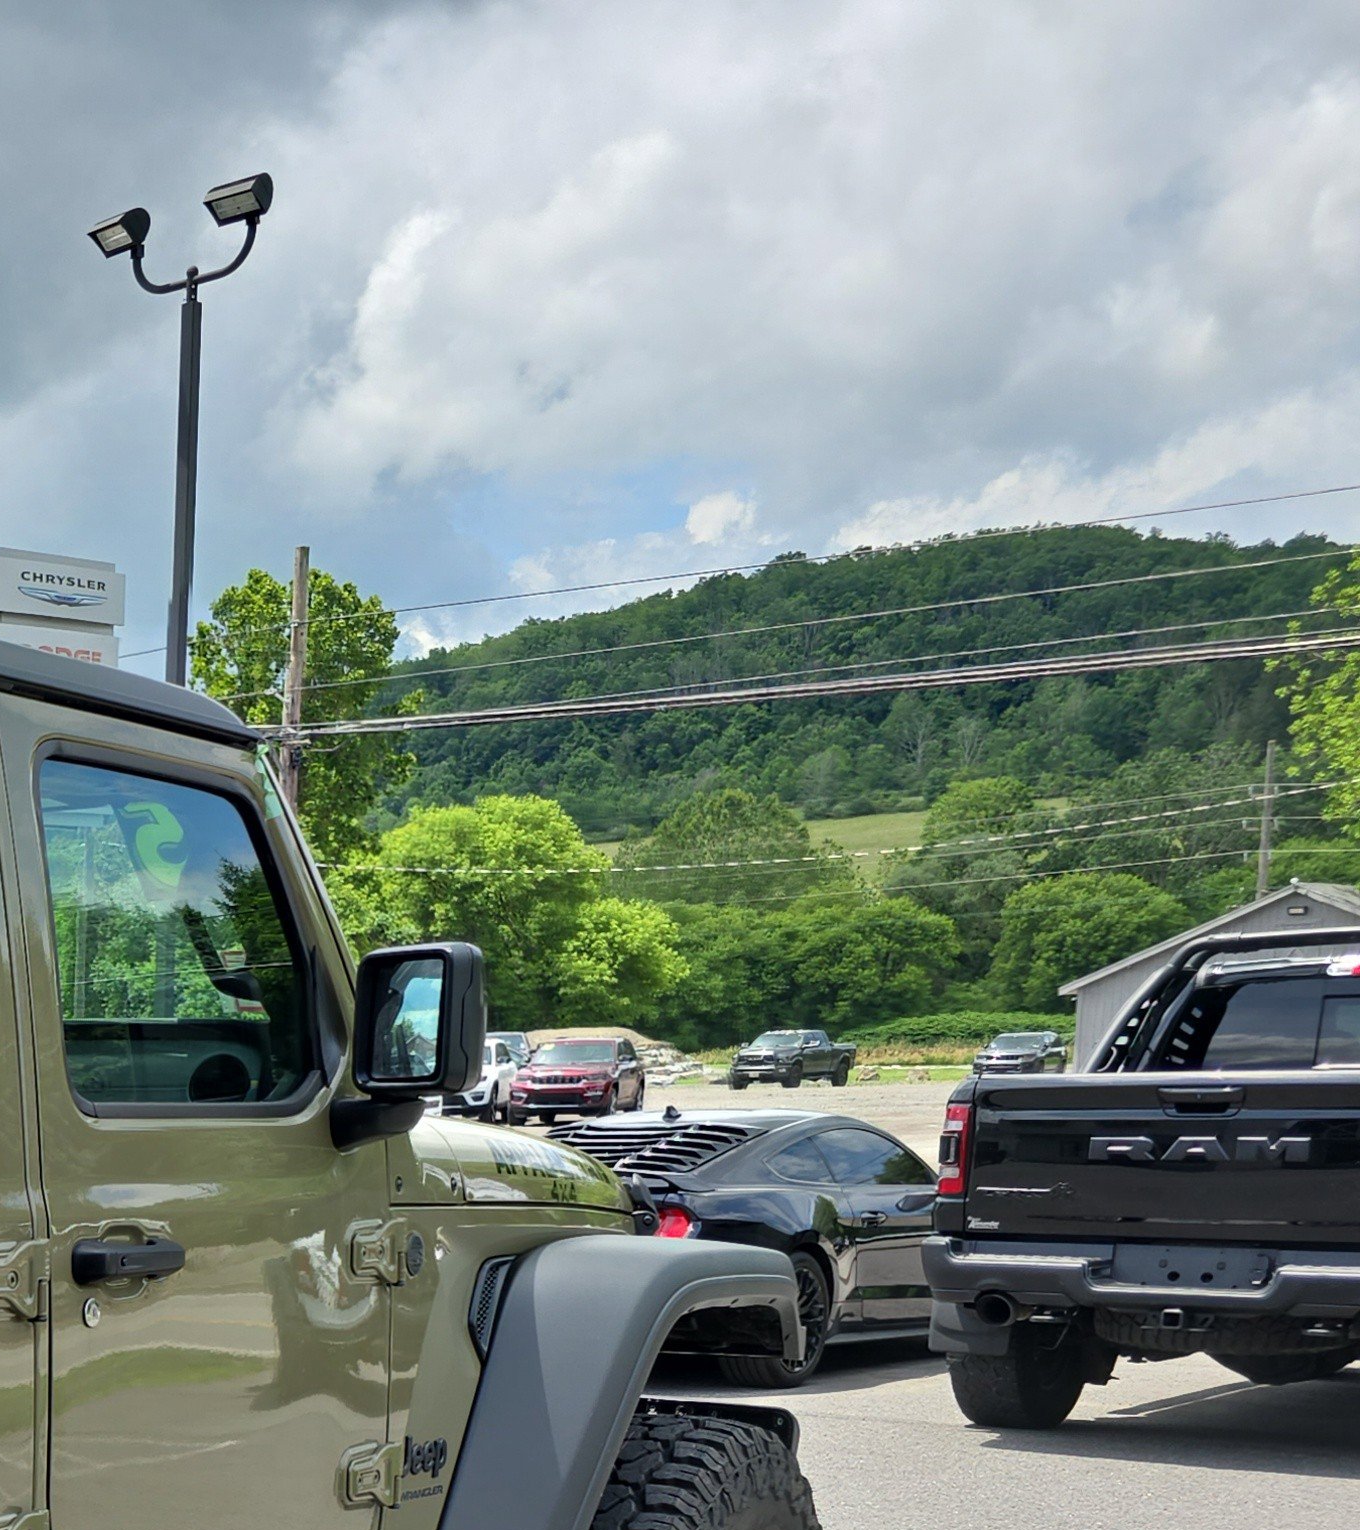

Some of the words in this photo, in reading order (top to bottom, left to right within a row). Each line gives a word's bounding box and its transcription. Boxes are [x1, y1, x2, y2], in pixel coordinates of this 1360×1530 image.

[20, 571, 107, 592] CHRYSLER
[23, 643, 102, 662] DGE
[1088, 1136, 1311, 1162] RAM
[402, 1435, 448, 1478] Jeep
